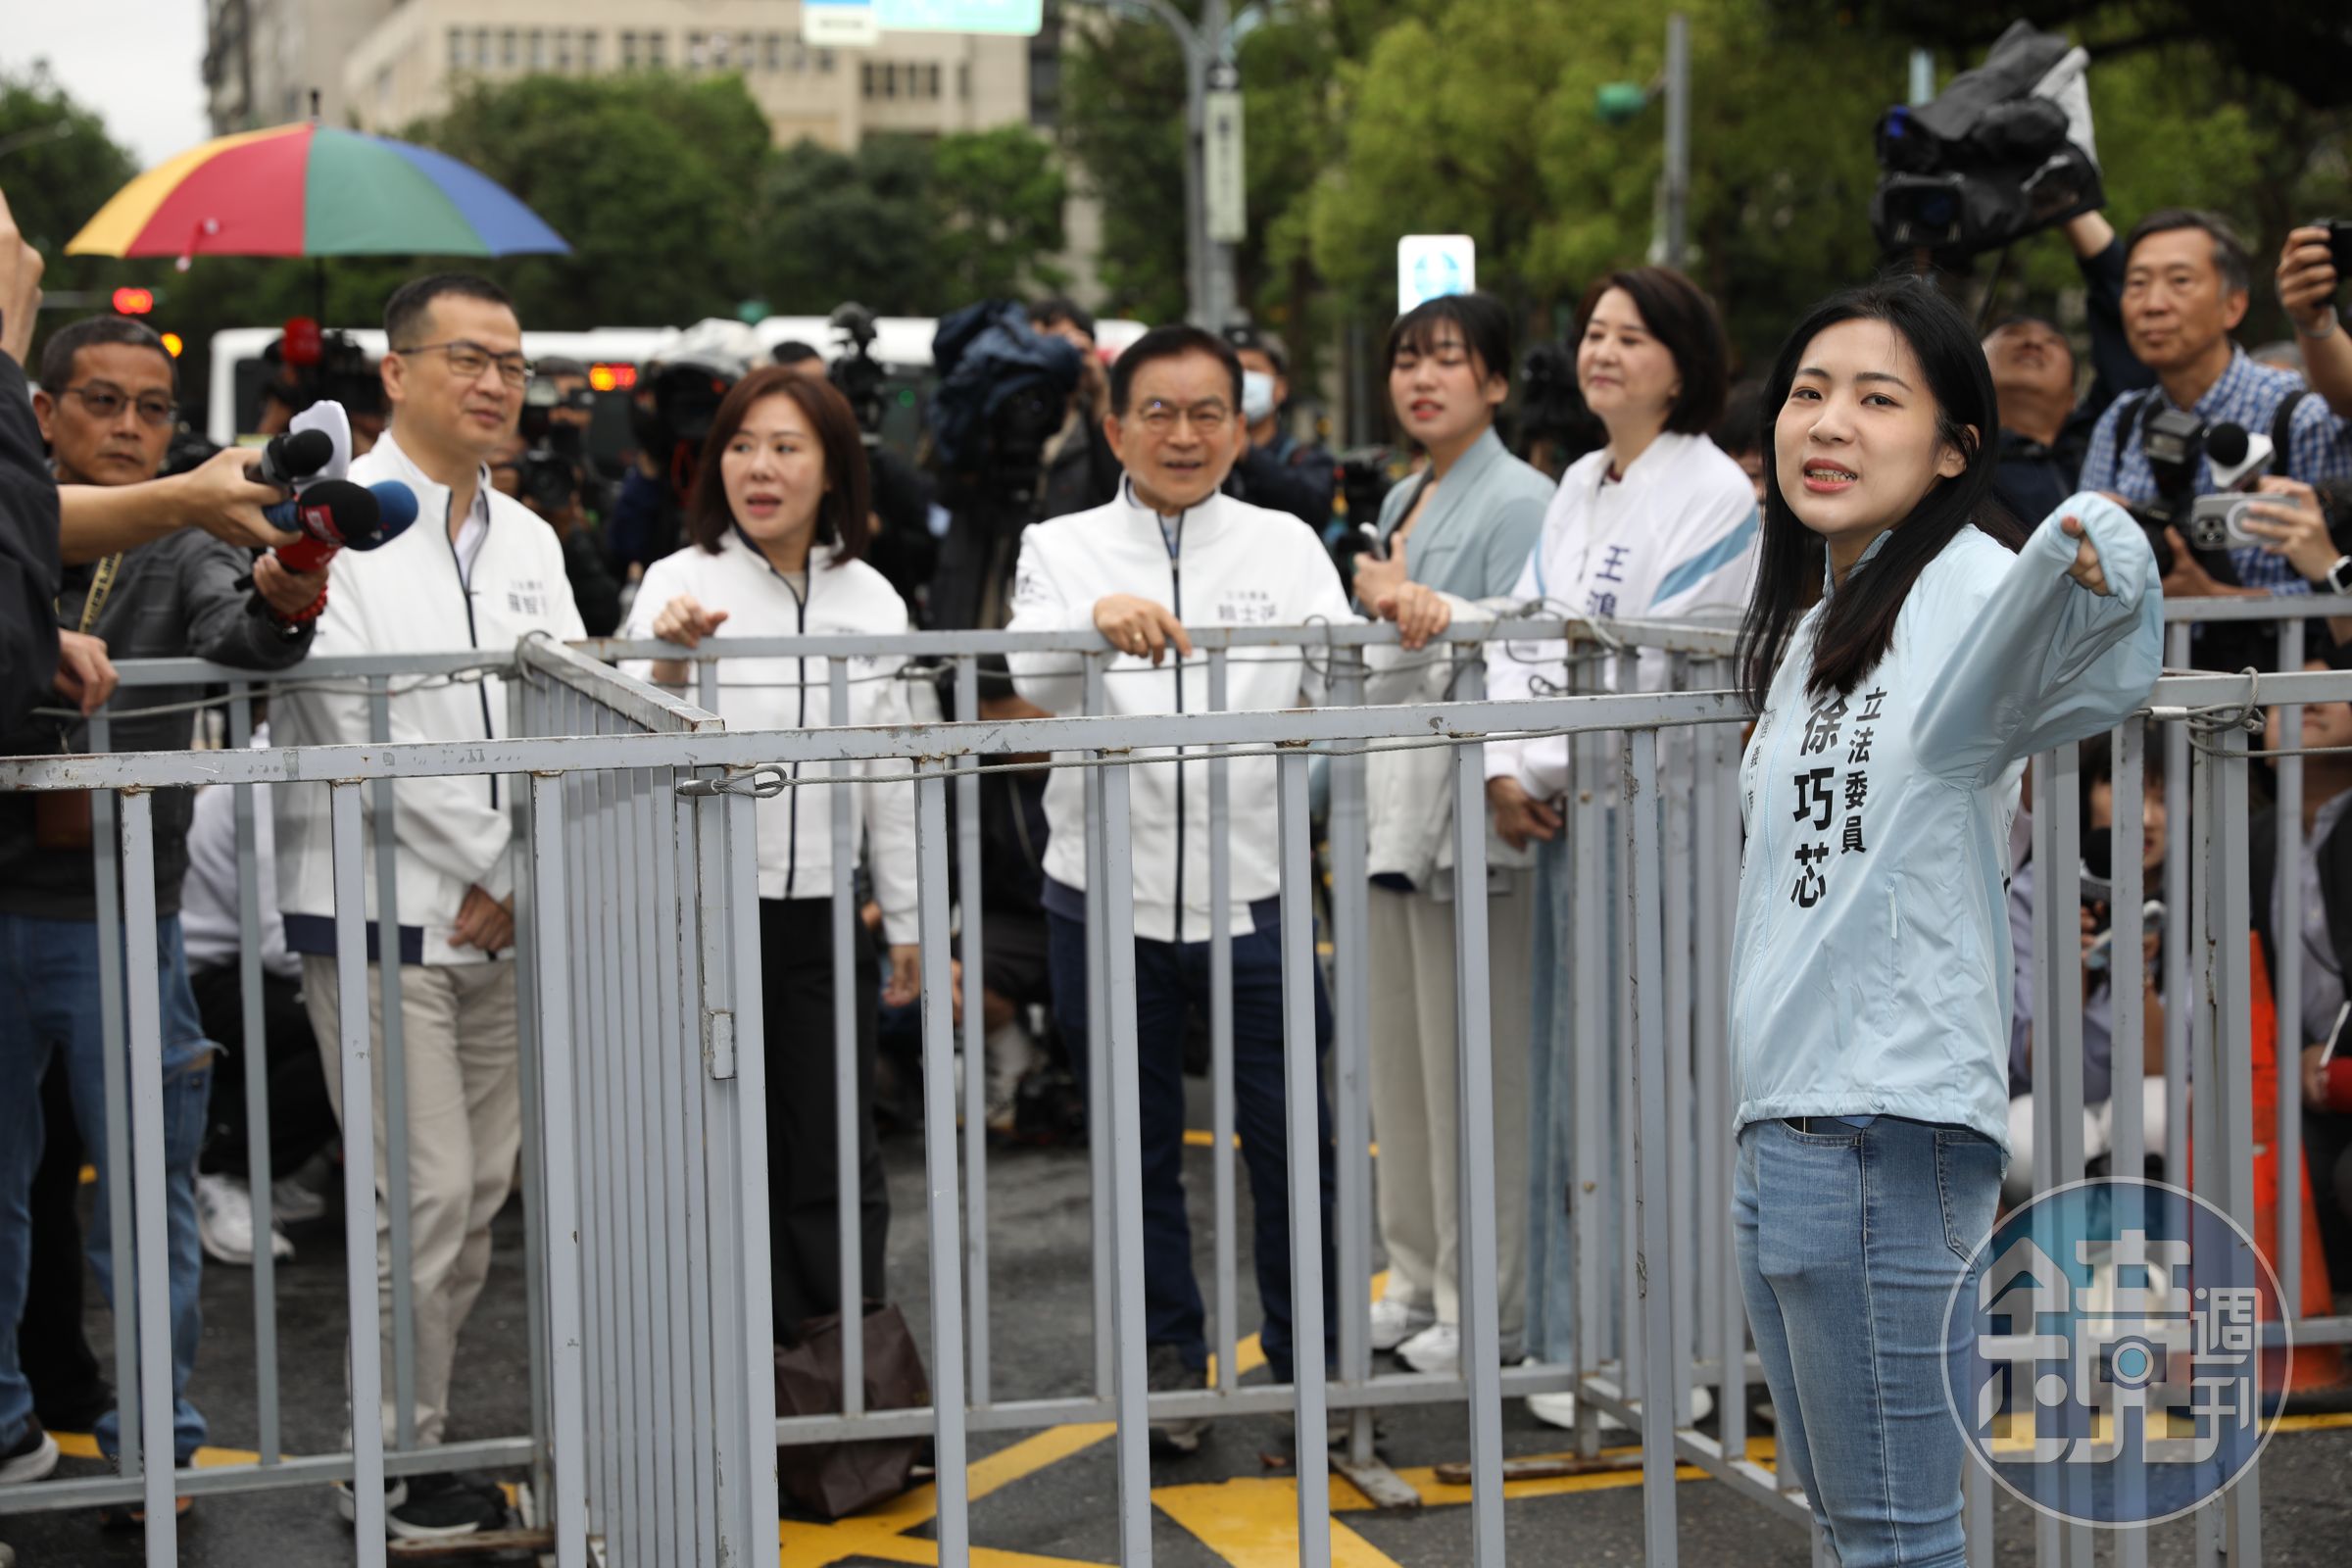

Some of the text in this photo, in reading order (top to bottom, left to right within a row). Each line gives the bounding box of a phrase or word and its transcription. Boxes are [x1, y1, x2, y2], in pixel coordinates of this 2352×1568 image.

[1790, 694, 1849, 908] 徐巧芯
[1841, 687, 1887, 855] 立法委員
